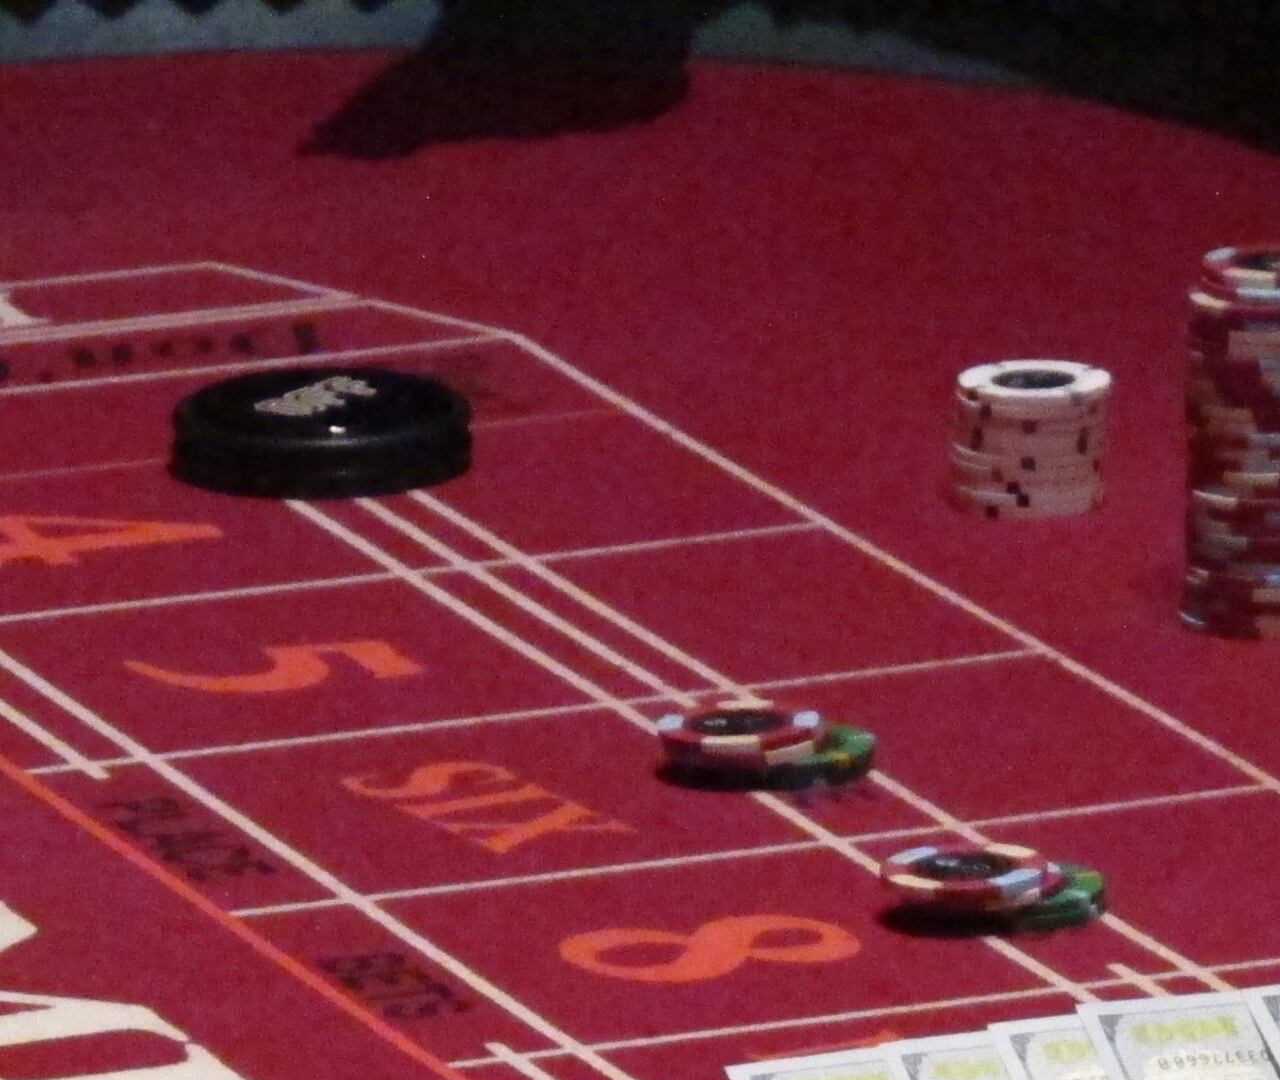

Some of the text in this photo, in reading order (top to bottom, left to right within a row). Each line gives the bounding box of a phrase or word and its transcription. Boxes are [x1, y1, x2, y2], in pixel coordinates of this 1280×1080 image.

[123, 640, 424, 692] 5
[341, 760, 636, 854] SIX
[560, 914, 862, 982] 8
